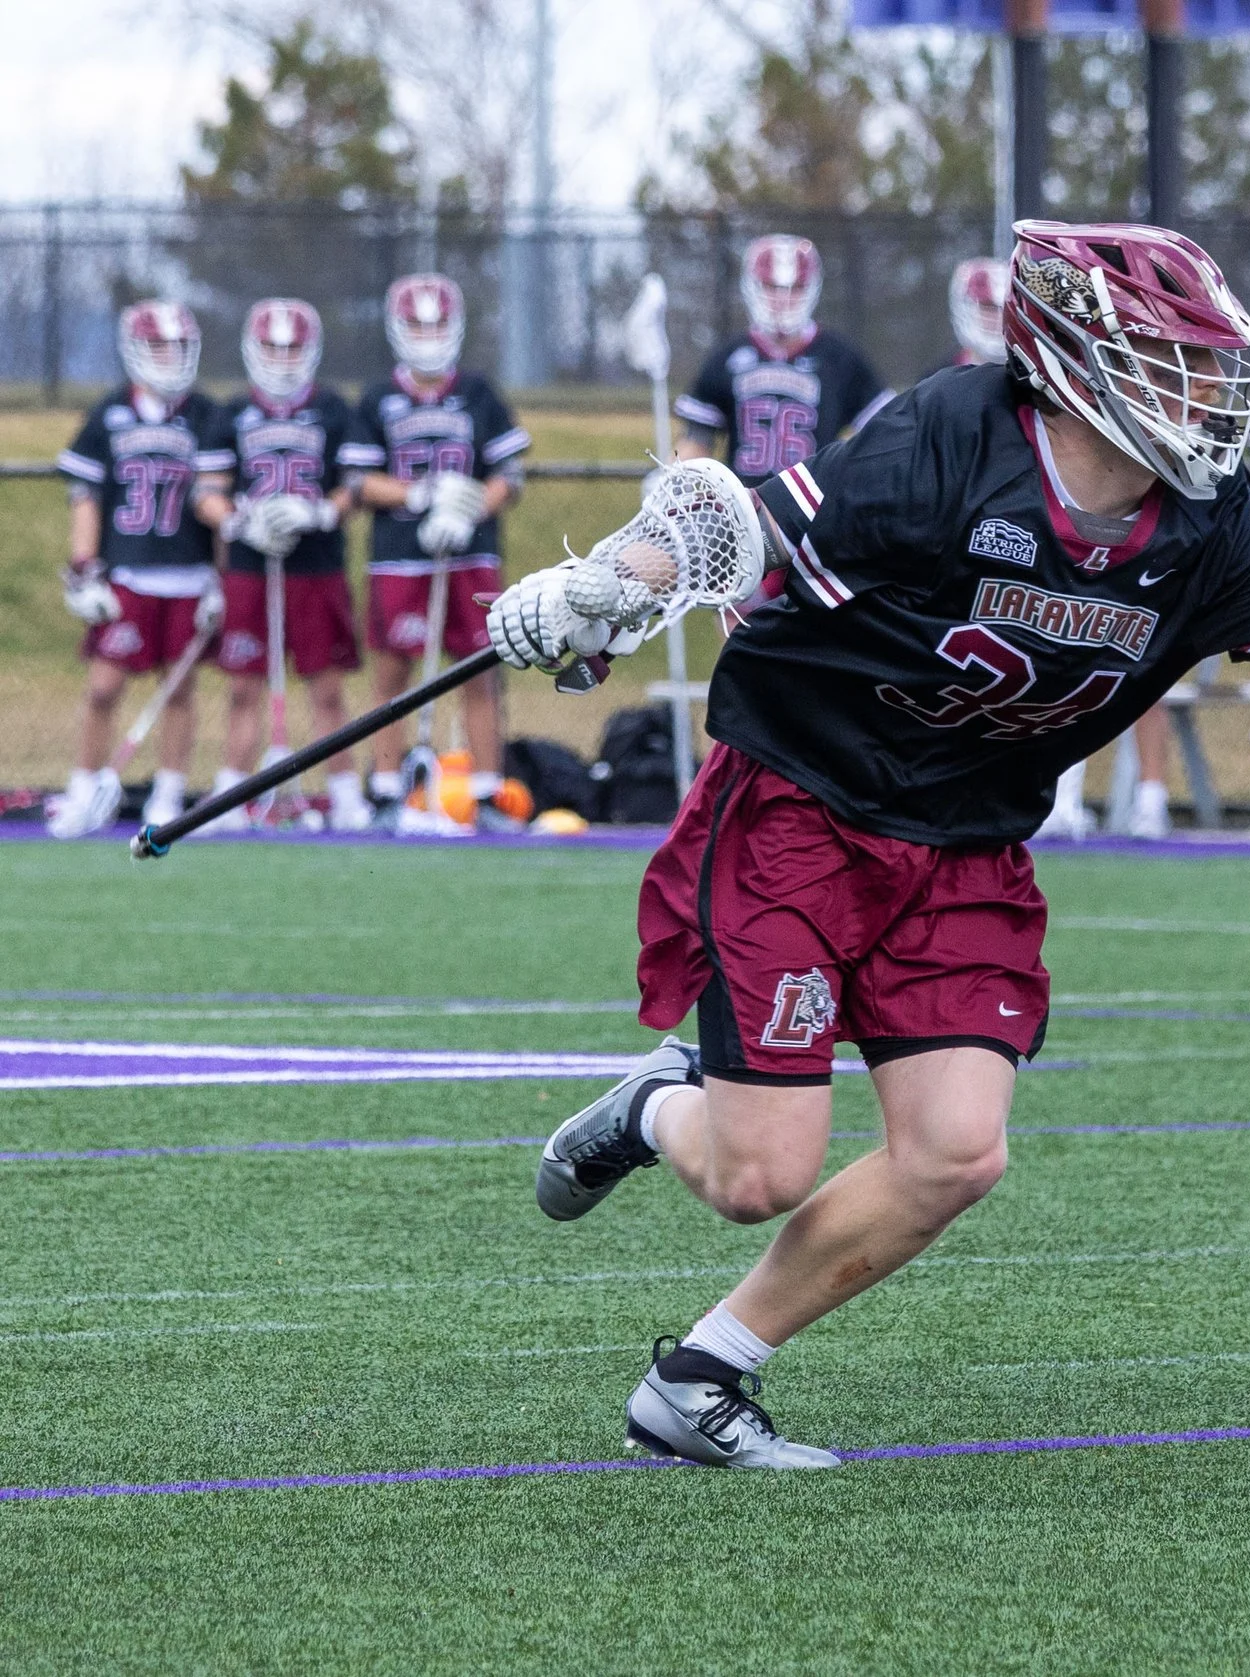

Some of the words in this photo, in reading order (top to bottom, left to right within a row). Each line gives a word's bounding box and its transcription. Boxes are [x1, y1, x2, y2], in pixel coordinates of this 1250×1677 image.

[734, 396, 818, 477] 56
[113, 454, 194, 537] 37
[973, 542, 1032, 563] LEAGUE
[974, 535, 1034, 553] PATRIOT
[975, 581, 1155, 656] LAFAYETTE
[875, 623, 1127, 740] 34
